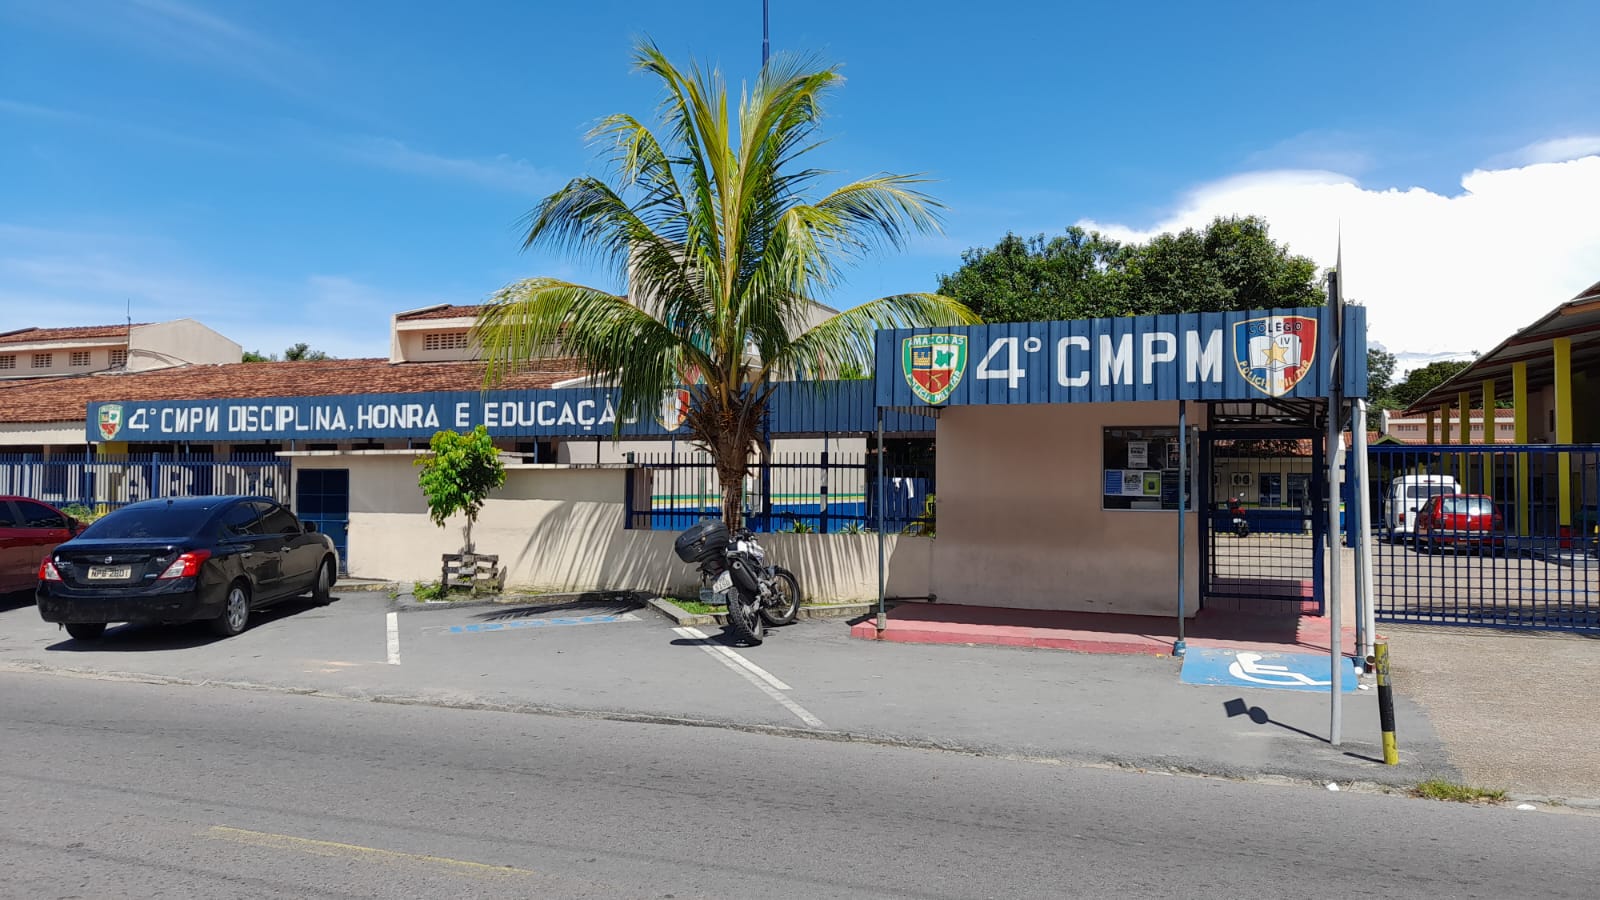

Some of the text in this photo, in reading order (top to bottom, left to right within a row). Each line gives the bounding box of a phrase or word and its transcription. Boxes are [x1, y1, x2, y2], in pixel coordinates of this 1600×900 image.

[1249, 322, 1302, 334] COLEGO
[1280, 337, 1290, 345] IV
[1057, 329, 1223, 387] CMPM
[228, 405, 353, 432] DISCIPLINA,
[357, 403, 440, 429] HONRA
[455, 402, 470, 427] E
